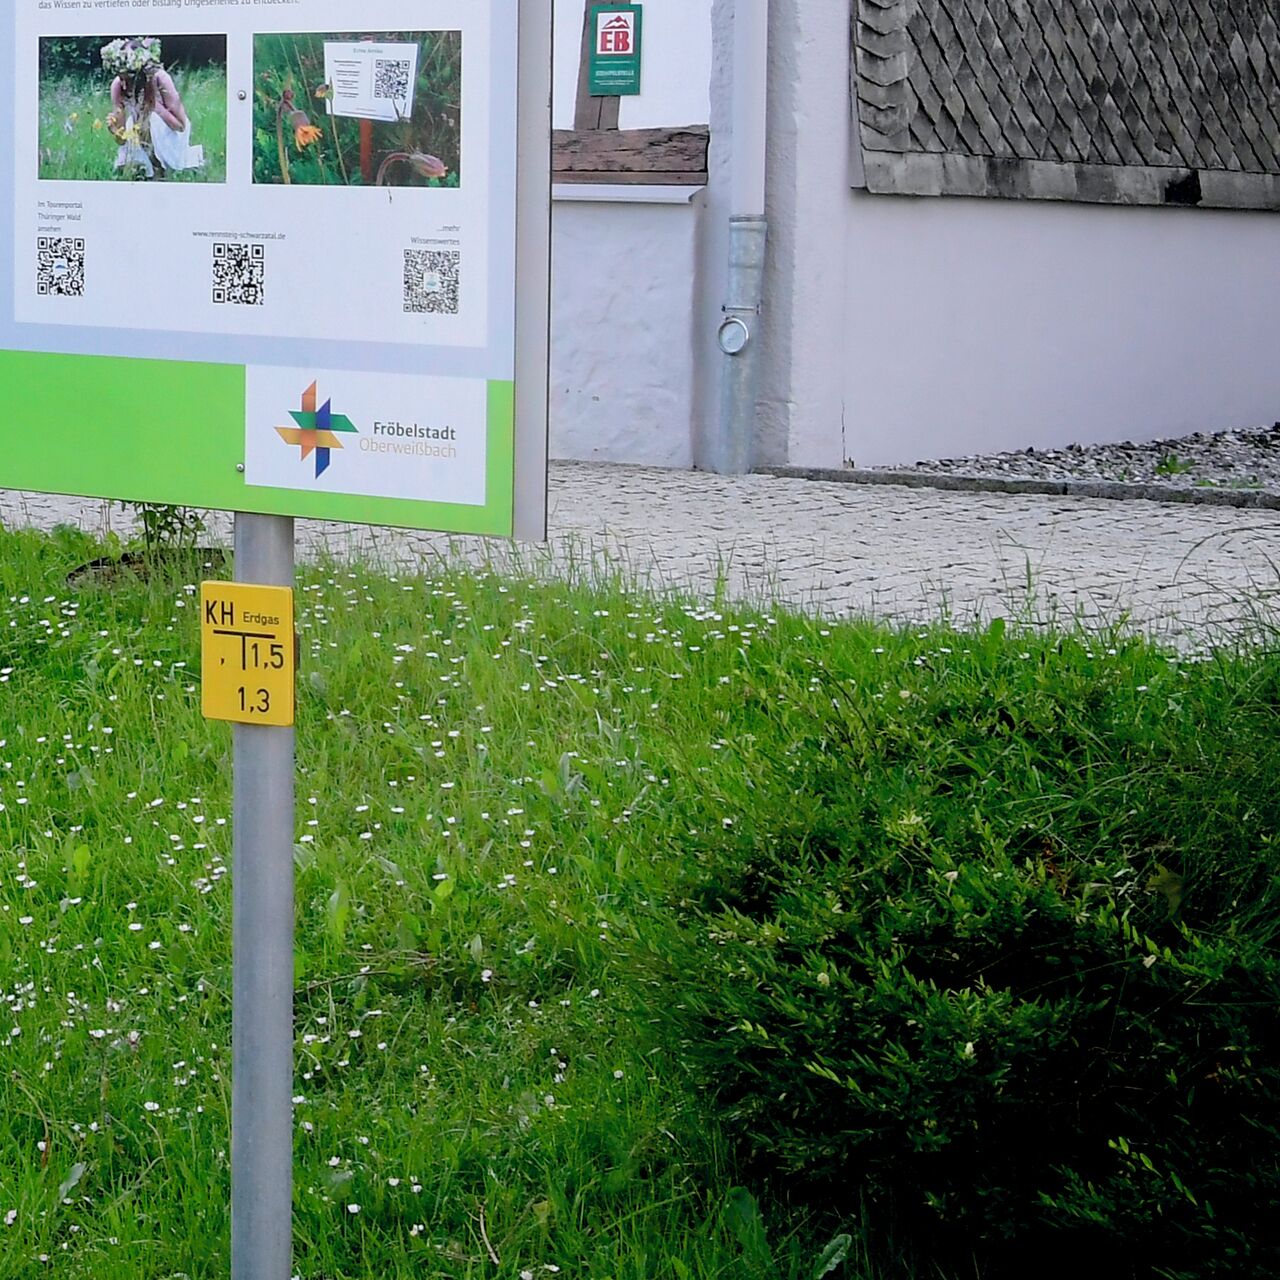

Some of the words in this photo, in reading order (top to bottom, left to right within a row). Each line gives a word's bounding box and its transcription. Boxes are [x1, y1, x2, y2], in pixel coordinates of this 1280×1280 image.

[600, 30, 630, 52] EB
[373, 421, 456, 441] Fröbelstadt
[359, 436, 457, 458] Oberweißbach
[205, 600, 234, 626] KH
[243, 611, 280, 626] Erdgas
[251, 643, 284, 669] 1,5
[237, 686, 271, 714] 1,3
